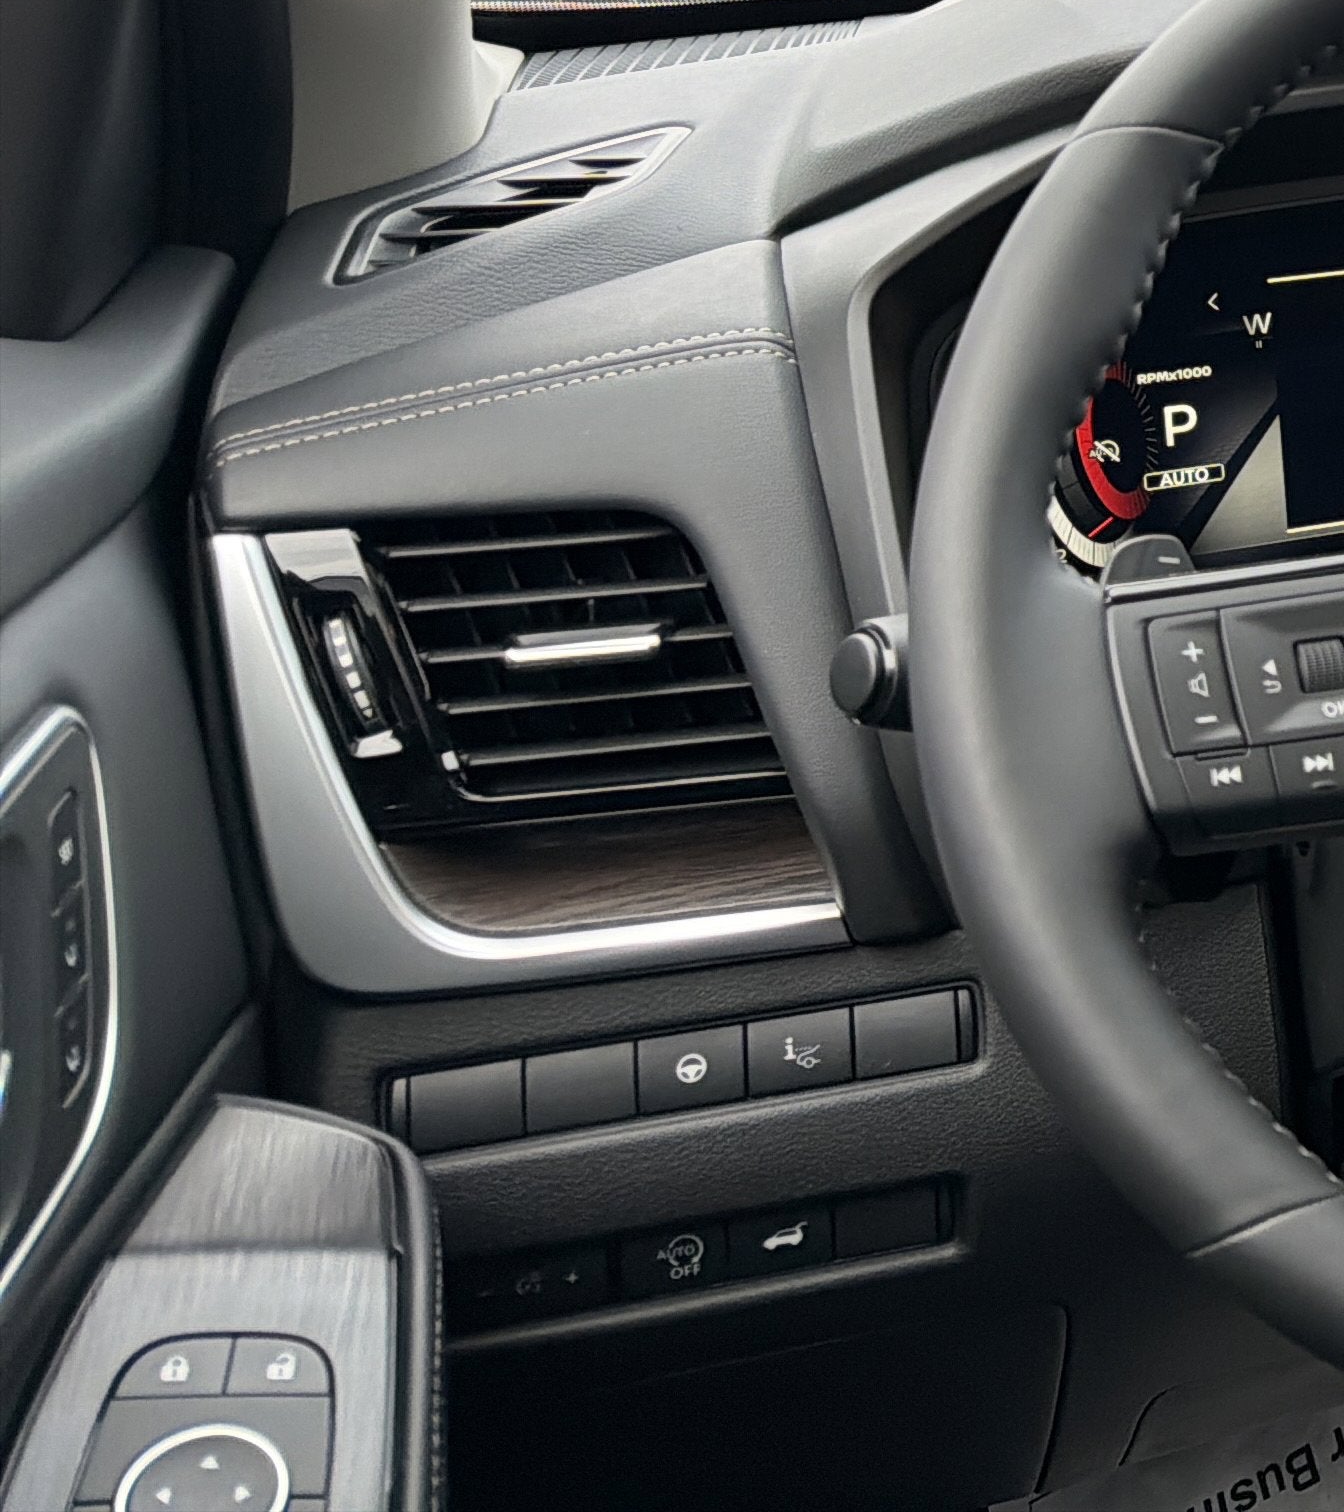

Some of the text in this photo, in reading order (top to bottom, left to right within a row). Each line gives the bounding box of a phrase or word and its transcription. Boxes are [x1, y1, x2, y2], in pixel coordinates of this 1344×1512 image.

[1242, 311, 1272, 336] W
[1136, 365, 1213, 387] RPMx1000
[1162, 402, 1199, 448] P
[1159, 466, 1210, 489] AUTO
[669, 1263, 701, 1280] OFF
